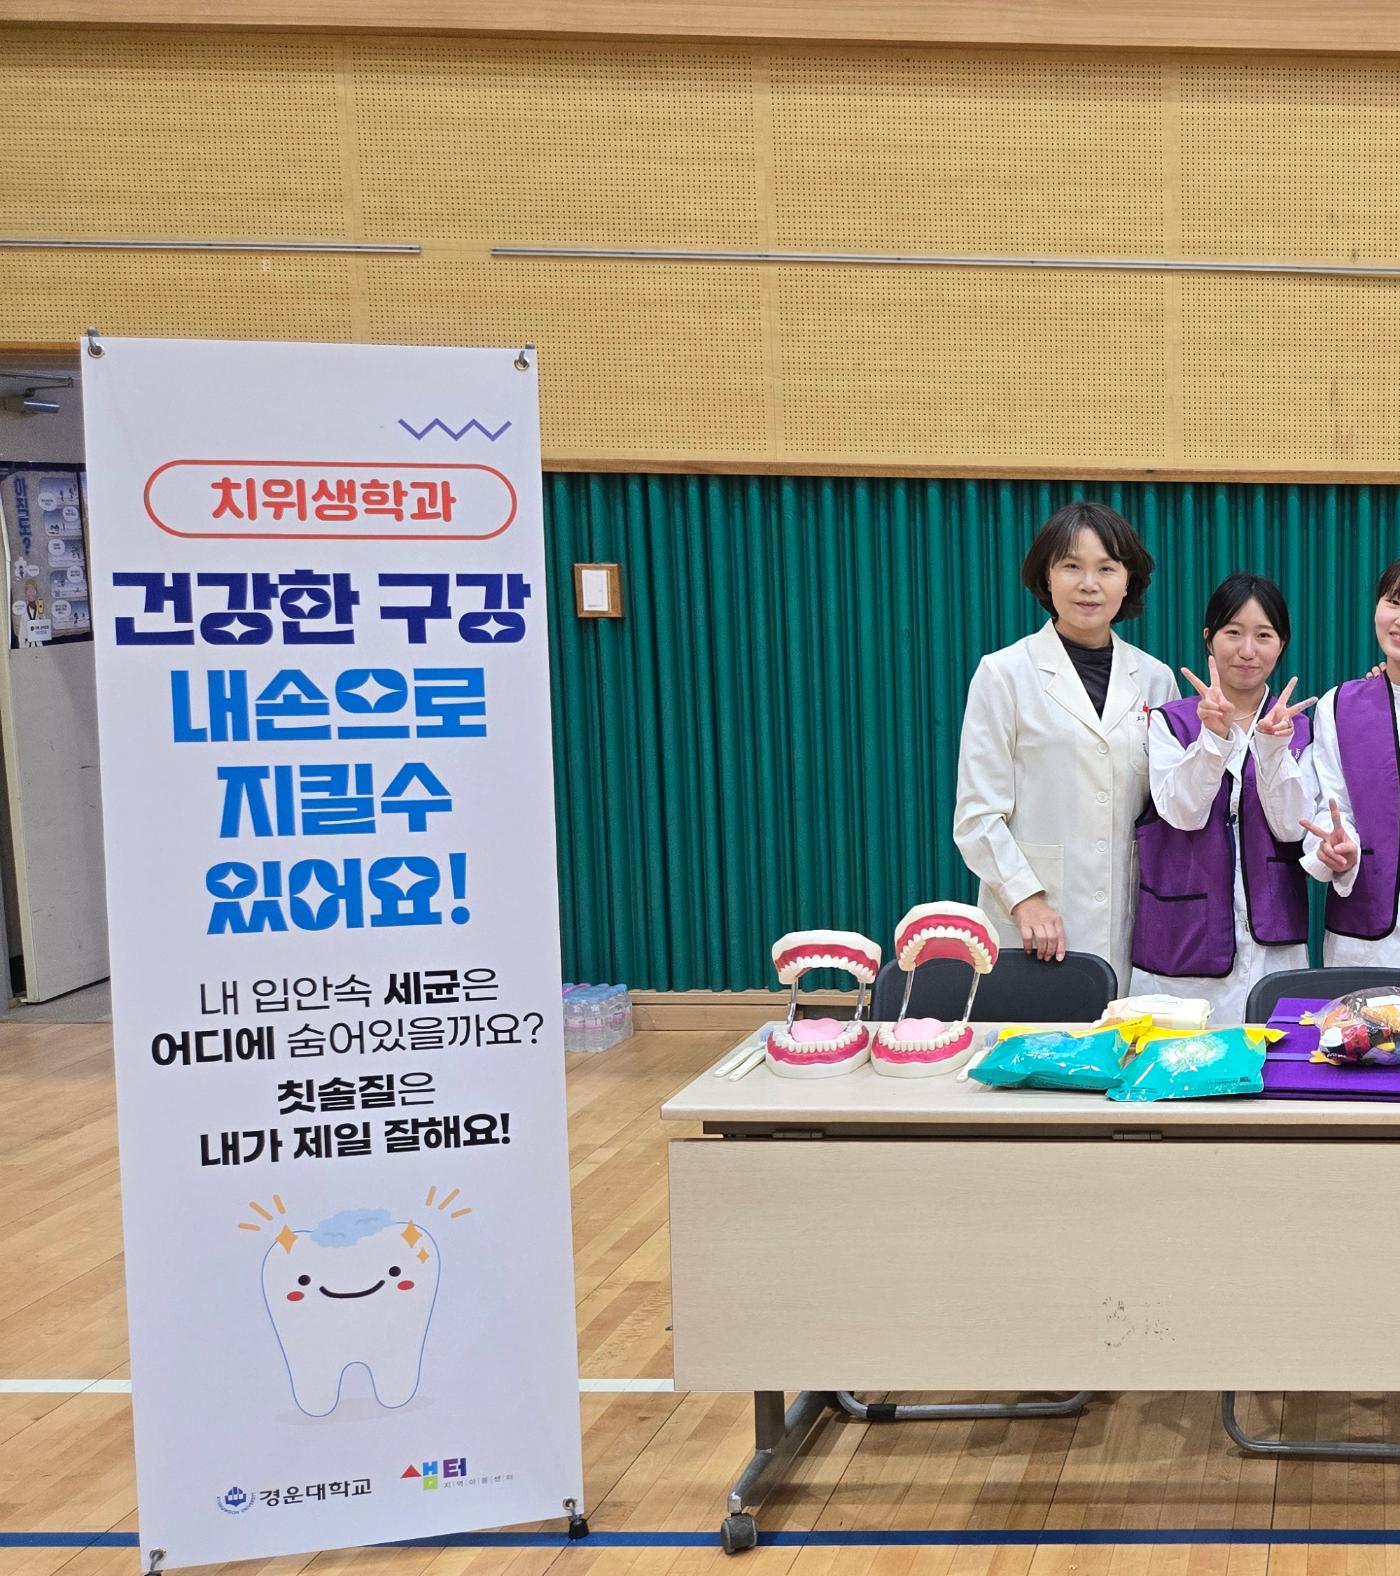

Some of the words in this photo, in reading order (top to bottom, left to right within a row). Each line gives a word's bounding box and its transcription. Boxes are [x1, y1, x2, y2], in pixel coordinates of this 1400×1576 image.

[211, 478, 457, 523] 치위생학과
[112, 569, 361, 647] 건강한
[378, 573, 532, 645] 구강
[170, 667, 488, 743] 내손으로
[217, 762, 453, 838] 지킬수
[206, 852, 471, 935] 있어요!
[200, 981, 239, 1016] 내
[253, 974, 373, 1015] 입안속
[385, 968, 499, 1006] 세균은
[151, 1026, 276, 1066] 어디에
[287, 1012, 544, 1059] 숨어있을까요?
[277, 1072, 436, 1115] 칫솔질은
[200, 1129, 283, 1167] 내가
[294, 1122, 373, 1160] 제일
[384, 1113, 511, 1154] 잘해요!
[259, 1478, 372, 1507] 경운대학교
